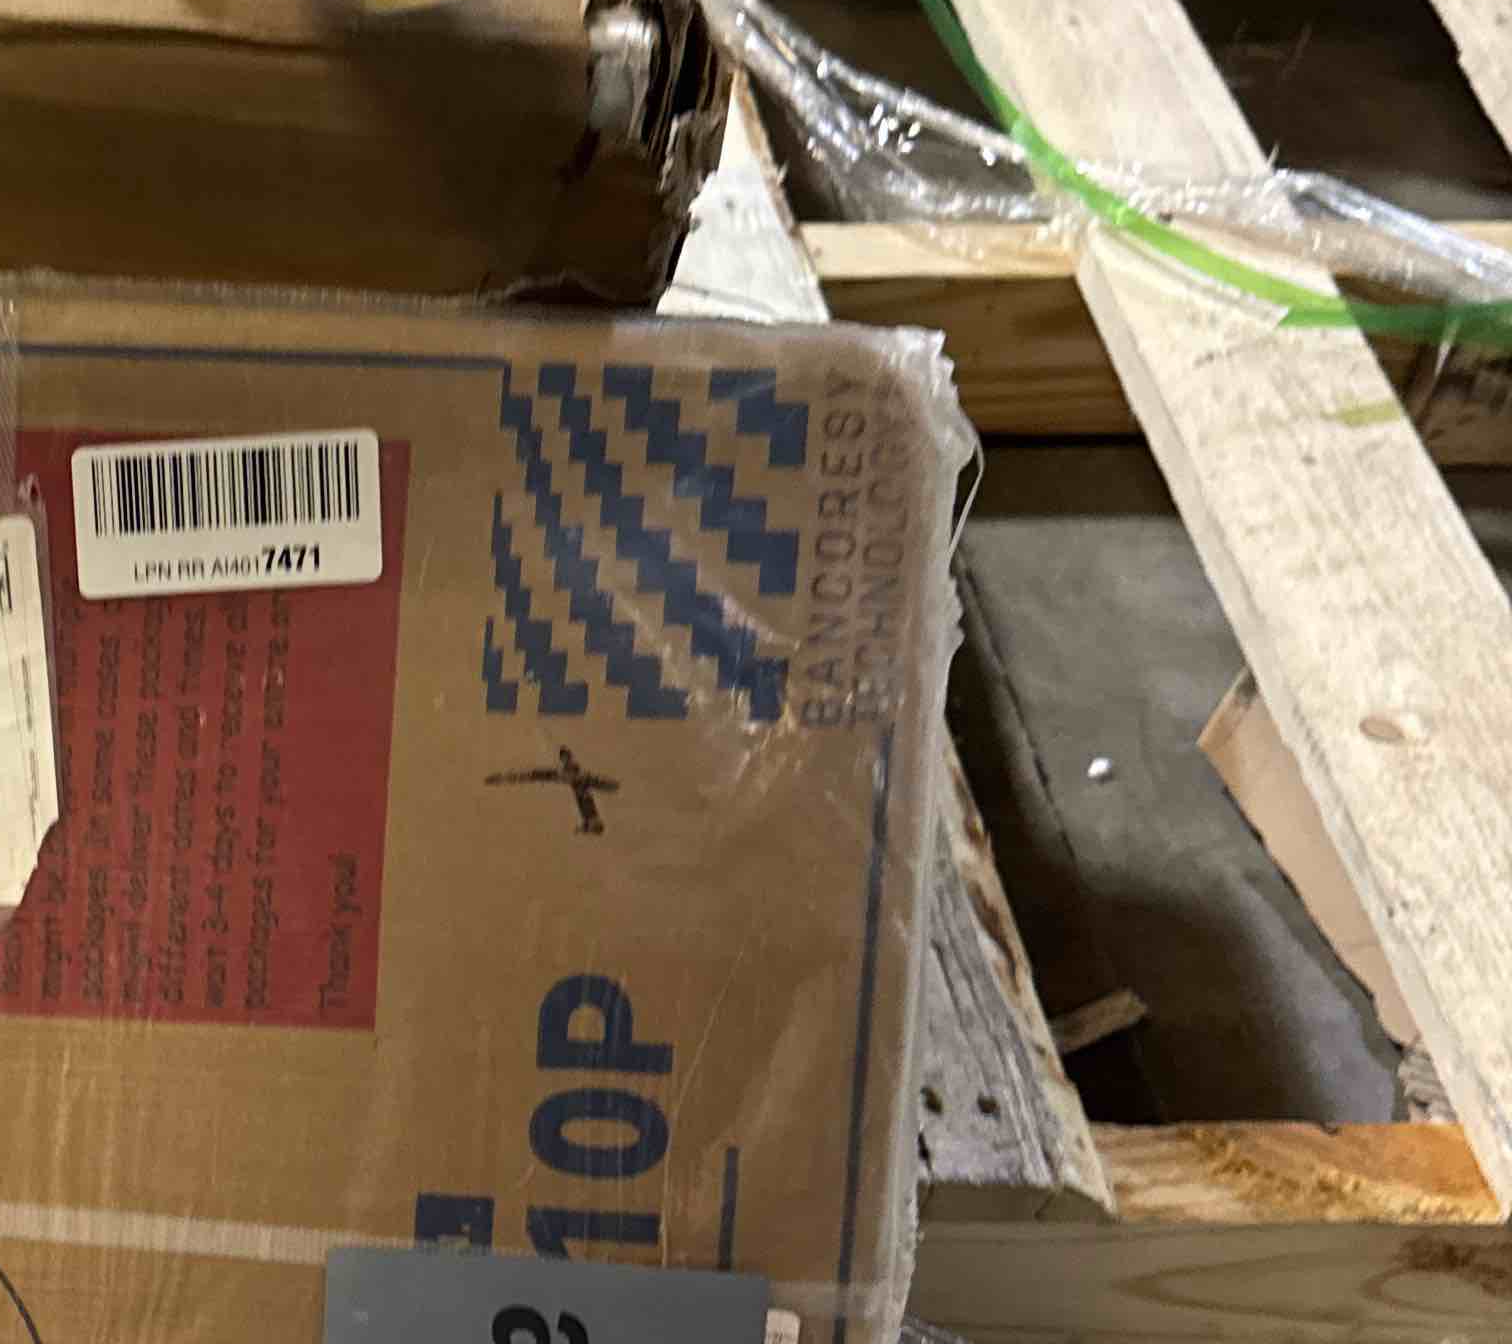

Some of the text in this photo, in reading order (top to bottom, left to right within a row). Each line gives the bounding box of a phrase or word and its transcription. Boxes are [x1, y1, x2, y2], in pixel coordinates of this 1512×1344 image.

[133, 558, 171, 584] LPN
[214, 765, 239, 795] to
[206, 805, 242, 874] days
[247, 817, 279, 865] for
[319, 927, 352, 1010] Thank
